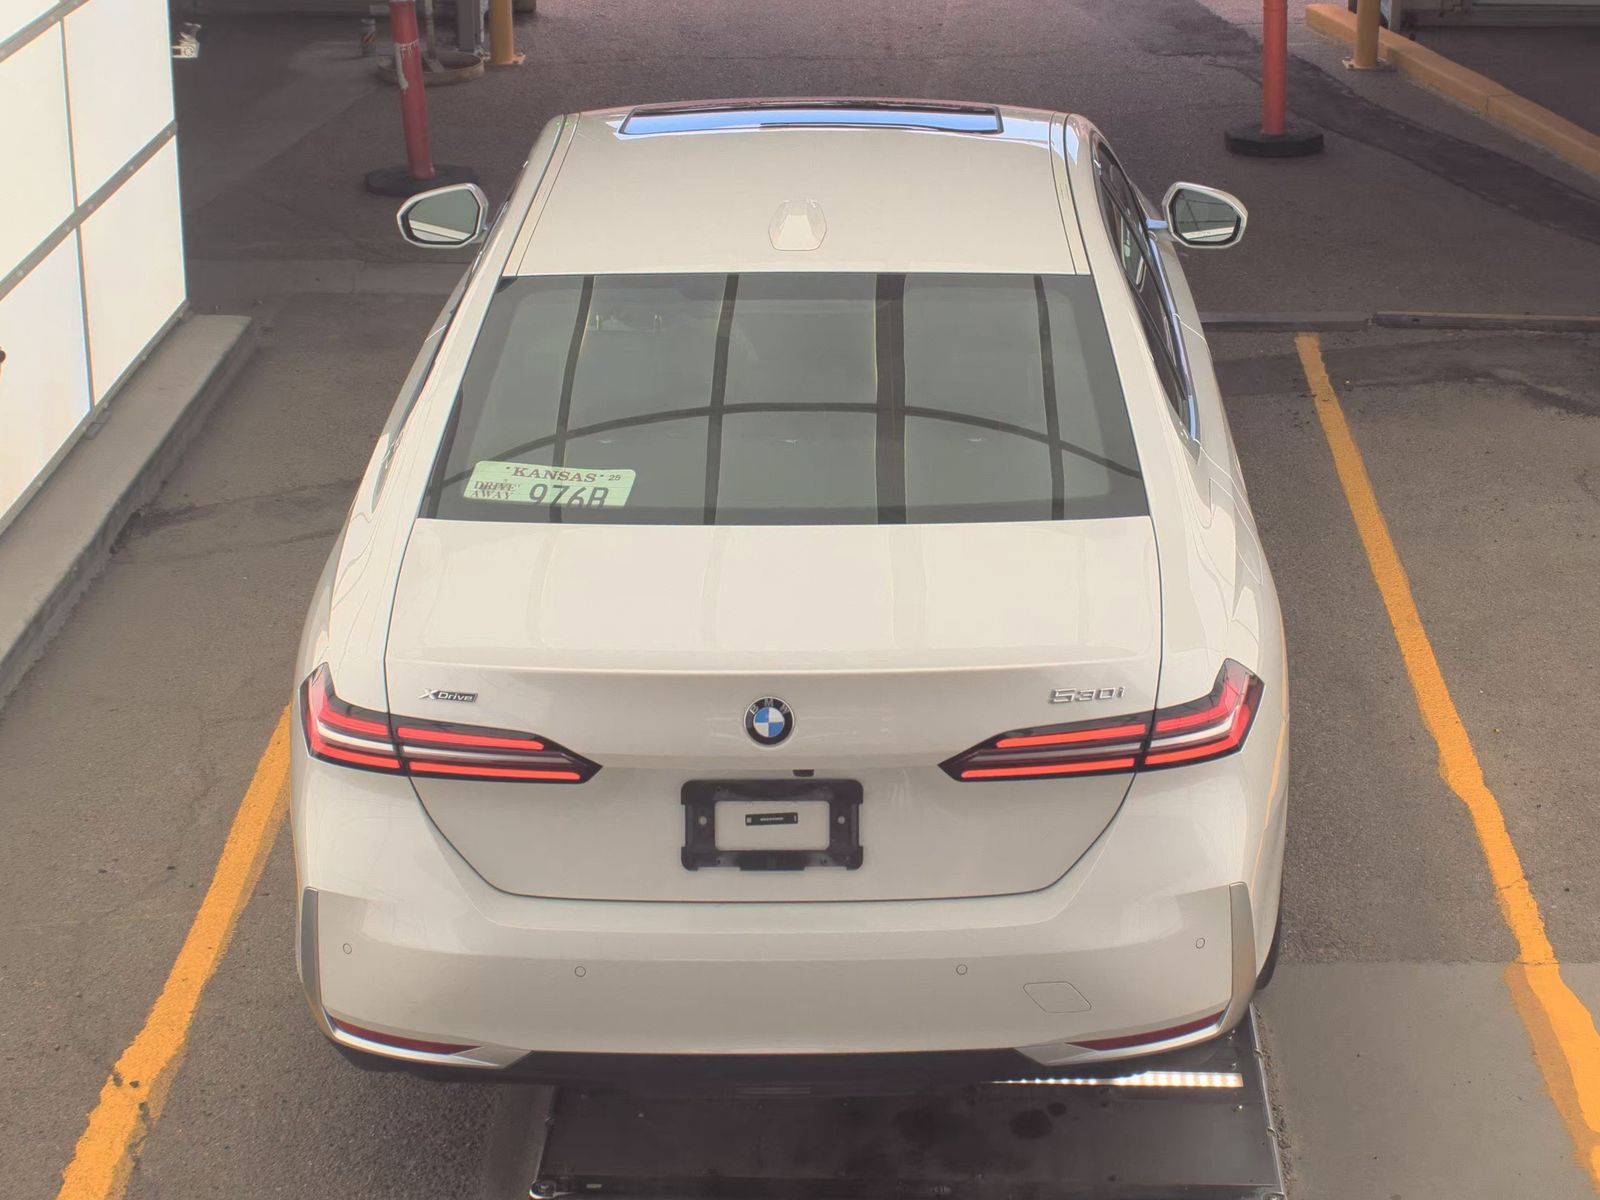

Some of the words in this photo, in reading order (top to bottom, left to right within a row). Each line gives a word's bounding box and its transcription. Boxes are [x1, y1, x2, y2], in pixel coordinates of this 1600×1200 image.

[512, 466, 597, 483] KANSAS
[474, 480, 517, 491] DRIVE
[470, 489, 514, 500] AWAY
[1049, 686, 1126, 704] 530i
